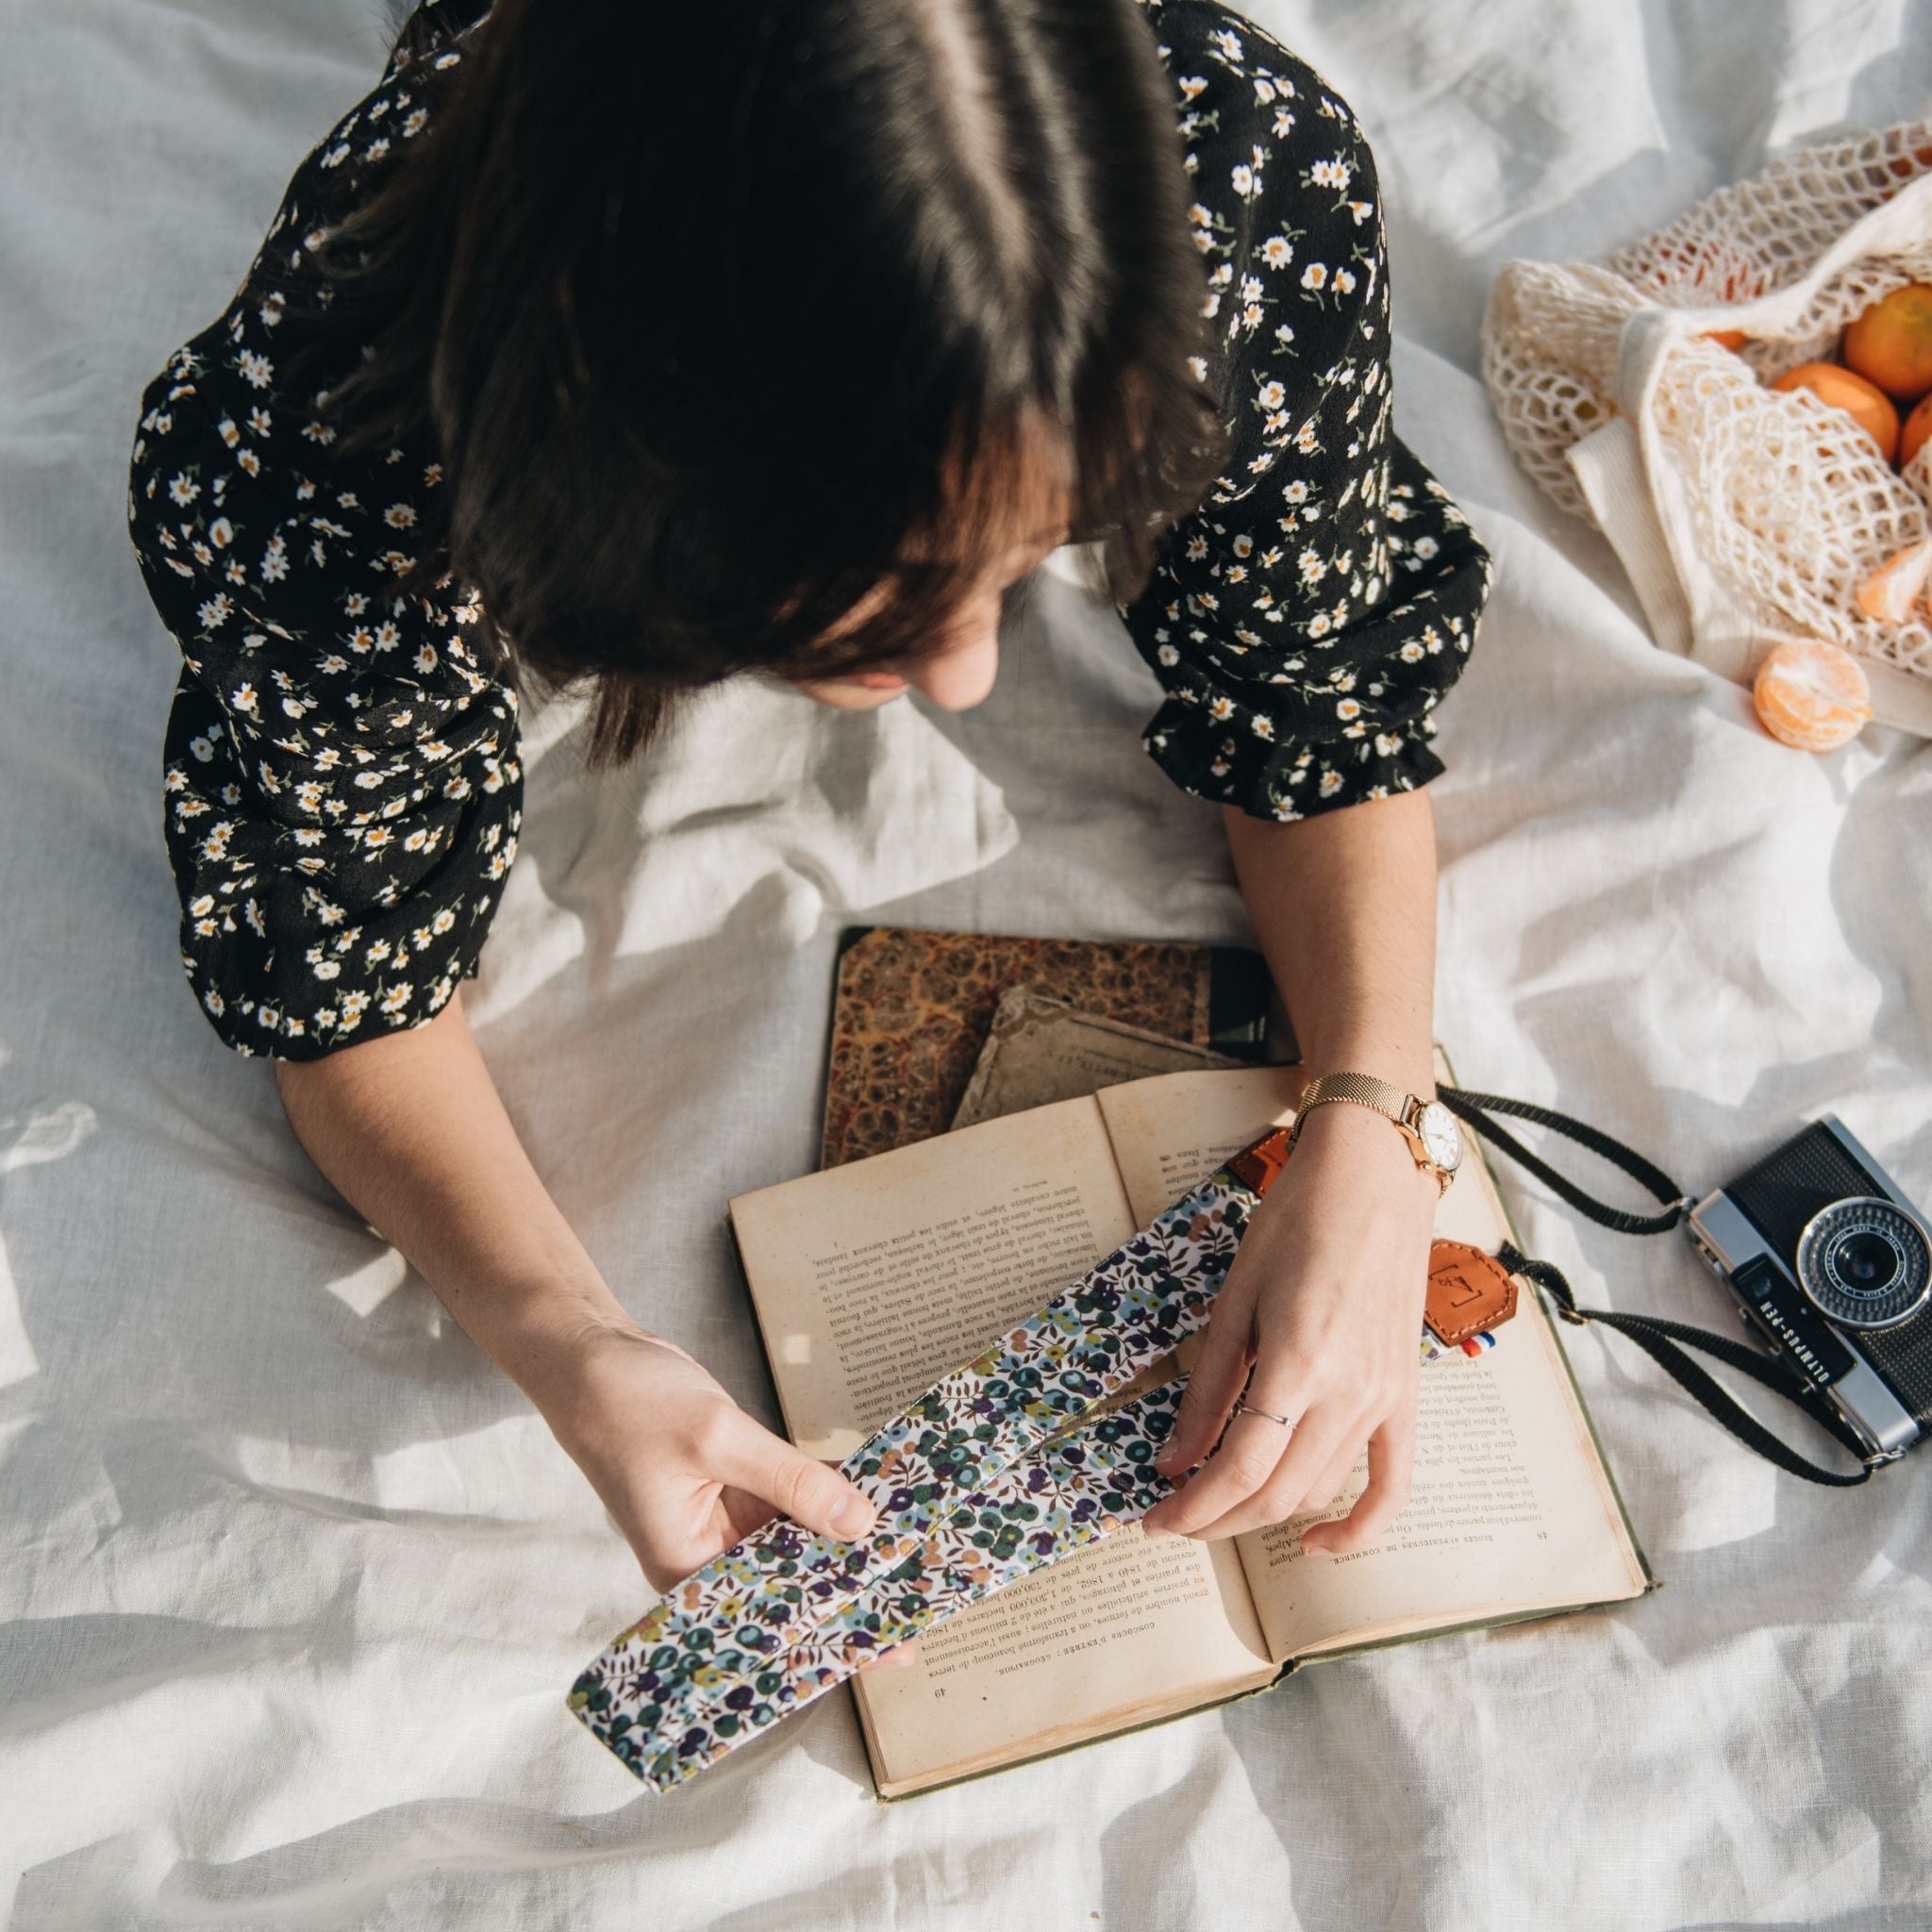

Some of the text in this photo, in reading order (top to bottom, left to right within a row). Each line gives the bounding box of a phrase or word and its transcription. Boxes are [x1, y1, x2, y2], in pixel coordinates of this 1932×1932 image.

[1176, 1149, 1199, 1158] Dans
[1164, 1172, 1198, 1184] nombre
[1054, 1185, 1076, 1196] notre
[1001, 1208, 1030, 1225] cheval
[891, 1229, 915, 1245] petits
[919, 1226, 932, 1236] les
[935, 1207, 1084, 1256] cheval limousin, types chevaux
[966, 1222, 986, 1236] trait
[1017, 1229, 1046, 1245] cheval
[852, 1240, 888, 1256] chevaux
[982, 1240, 1001, 1254] gros
[1004, 1239, 1015, 1248] de
[838, 1254, 881, 1275] recherché
[1012, 1258, 1035, 1271] forte
[1036, 1254, 1048, 1264] de
[814, 1265, 835, 1280] pour
[848, 1233, 1078, 1308] lait riche beurre, pour les chevaux, la race
[915, 1260, 944, 1277] cheval
[958, 1265, 1010, 1285] corpulence,
[845, 1270, 911, 1298] anglo-normand
[926, 1285, 945, 1296] race
[947, 1281, 957, 1291] la
[832, 1256, 1089, 1339] race bretonne, de petite taille, mais bonne laitière, la race
[880, 1295, 911, 1310] Salers,
[913, 1291, 924, 1302] de
[836, 1270, 1083, 1351] normande et la race mancelle, propres l'engraissement,
[862, 1304, 878, 1319] qui
[828, 1311, 860, 1329] fournit
[839, 1291, 1049, 1363] les bovidés, la race flamande, bonne laitière, la
[842, 1321, 999, 1374] aussi les races les plus renommées,
[1758, 1300, 1829, 1383] OLYMPUS-PEN
[846, 1339, 985, 1387] têtes de gros bétail que le reste
[850, 1364, 942, 1397] comptent proportion-
[853, 1389, 905, 1410] la frontière
[857, 1406, 894, 1422] départe-
[1291, 1511, 1331, 1531] consacré
[1260, 1525, 1290, 1541] depuis
[1462, 1534, 1493, 1543] ÉCOLES
[1535, 1530, 1548, 1540] 48
[1108, 1535, 1140, 1550] évalue
[1329, 1548, 1380, 1564] COMMERCE.
[1002, 1546, 1152, 1600] été encore de près de 730,000
[925, 1549, 1196, 1638] environ de 1840 1862, de 1,300,000 hectares de 1862
[920, 1562, 1201, 1652] des prairies et pâturages, qui été de 2 millions d'hectares
[924, 1576, 1189, 1667] prairies artificielles aussi l'accroissement
[927, 1586, 1208, 1678] grand nombre de fermes, transformé beaucoup de terres
[1110, 1621, 1155, 1641] CONCOURS
[1062, 1635, 1107, 1656] D'ENTRÉE
[933, 1686, 947, 1698] 49
